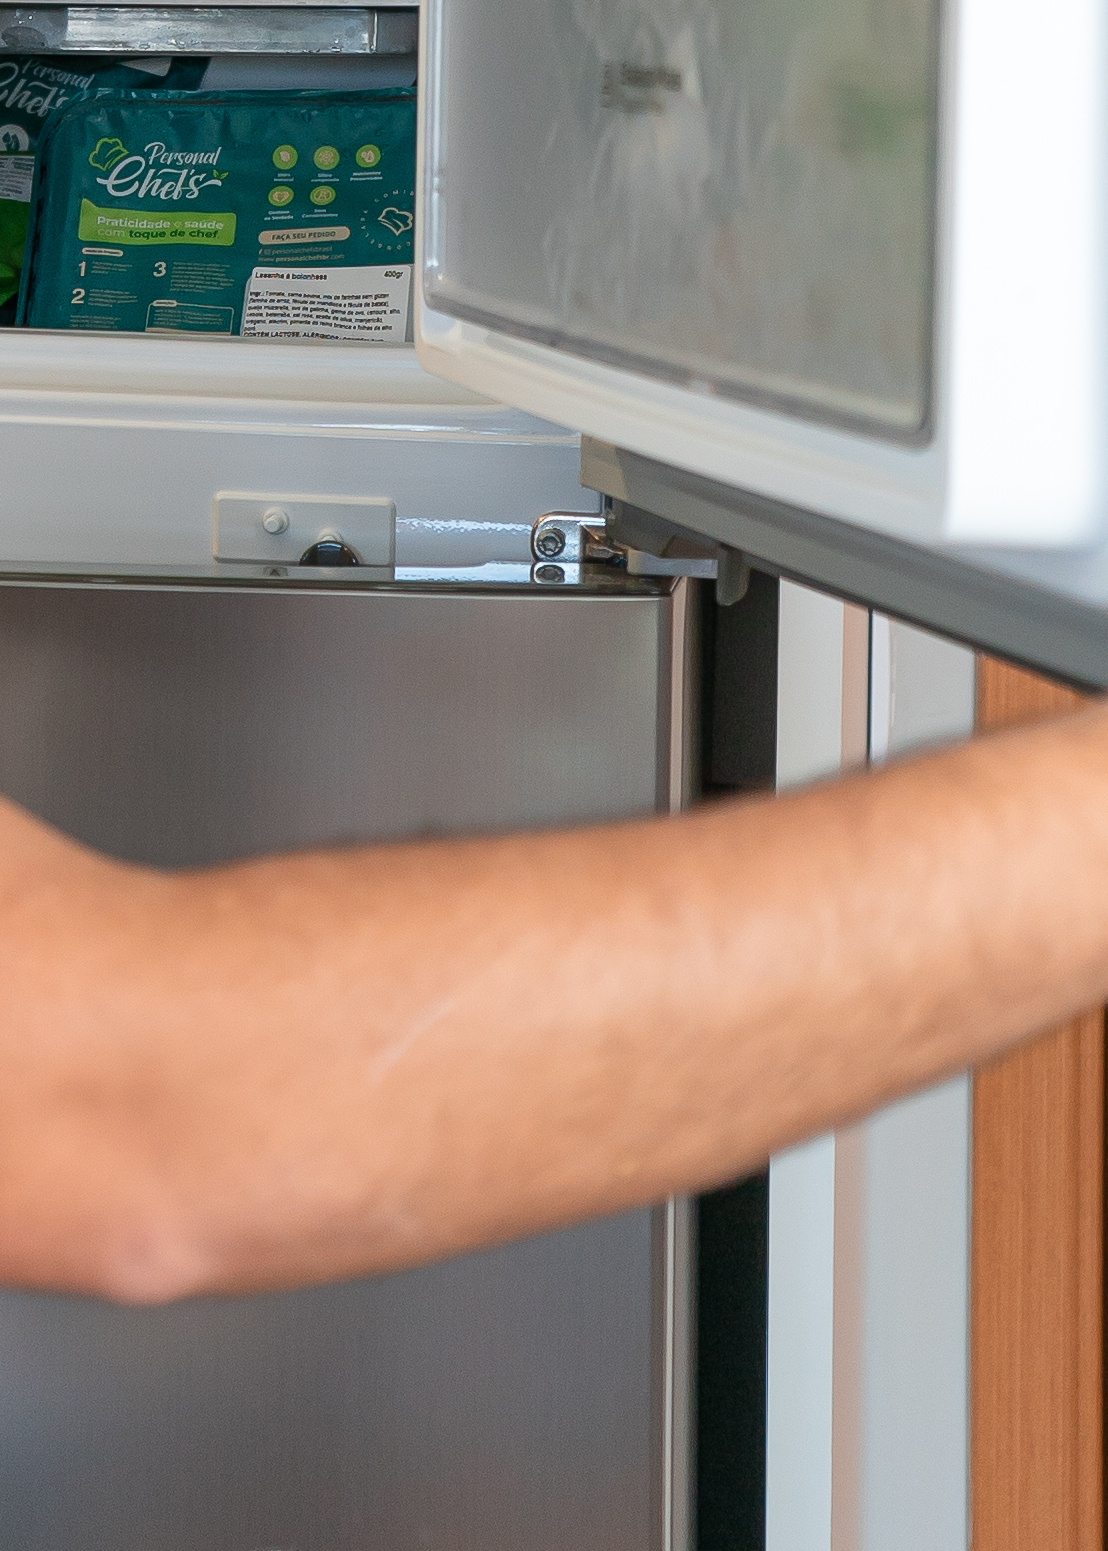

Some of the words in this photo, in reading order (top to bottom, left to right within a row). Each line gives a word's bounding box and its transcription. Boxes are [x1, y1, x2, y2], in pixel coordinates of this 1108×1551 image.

[21, 58, 96, 89] Personal
[144, 141, 222, 166] Personal
[97, 216, 171, 229] Praticidade
[184, 220, 224, 229] saúde
[97, 228, 125, 237] com
[129, 229, 167, 240] toque
[170, 229, 185, 238] de
[271, 233, 291, 242] FAÇA
[78, 261, 86, 277] 1
[153, 261, 167, 277] 3
[71, 288, 85, 304] 2
